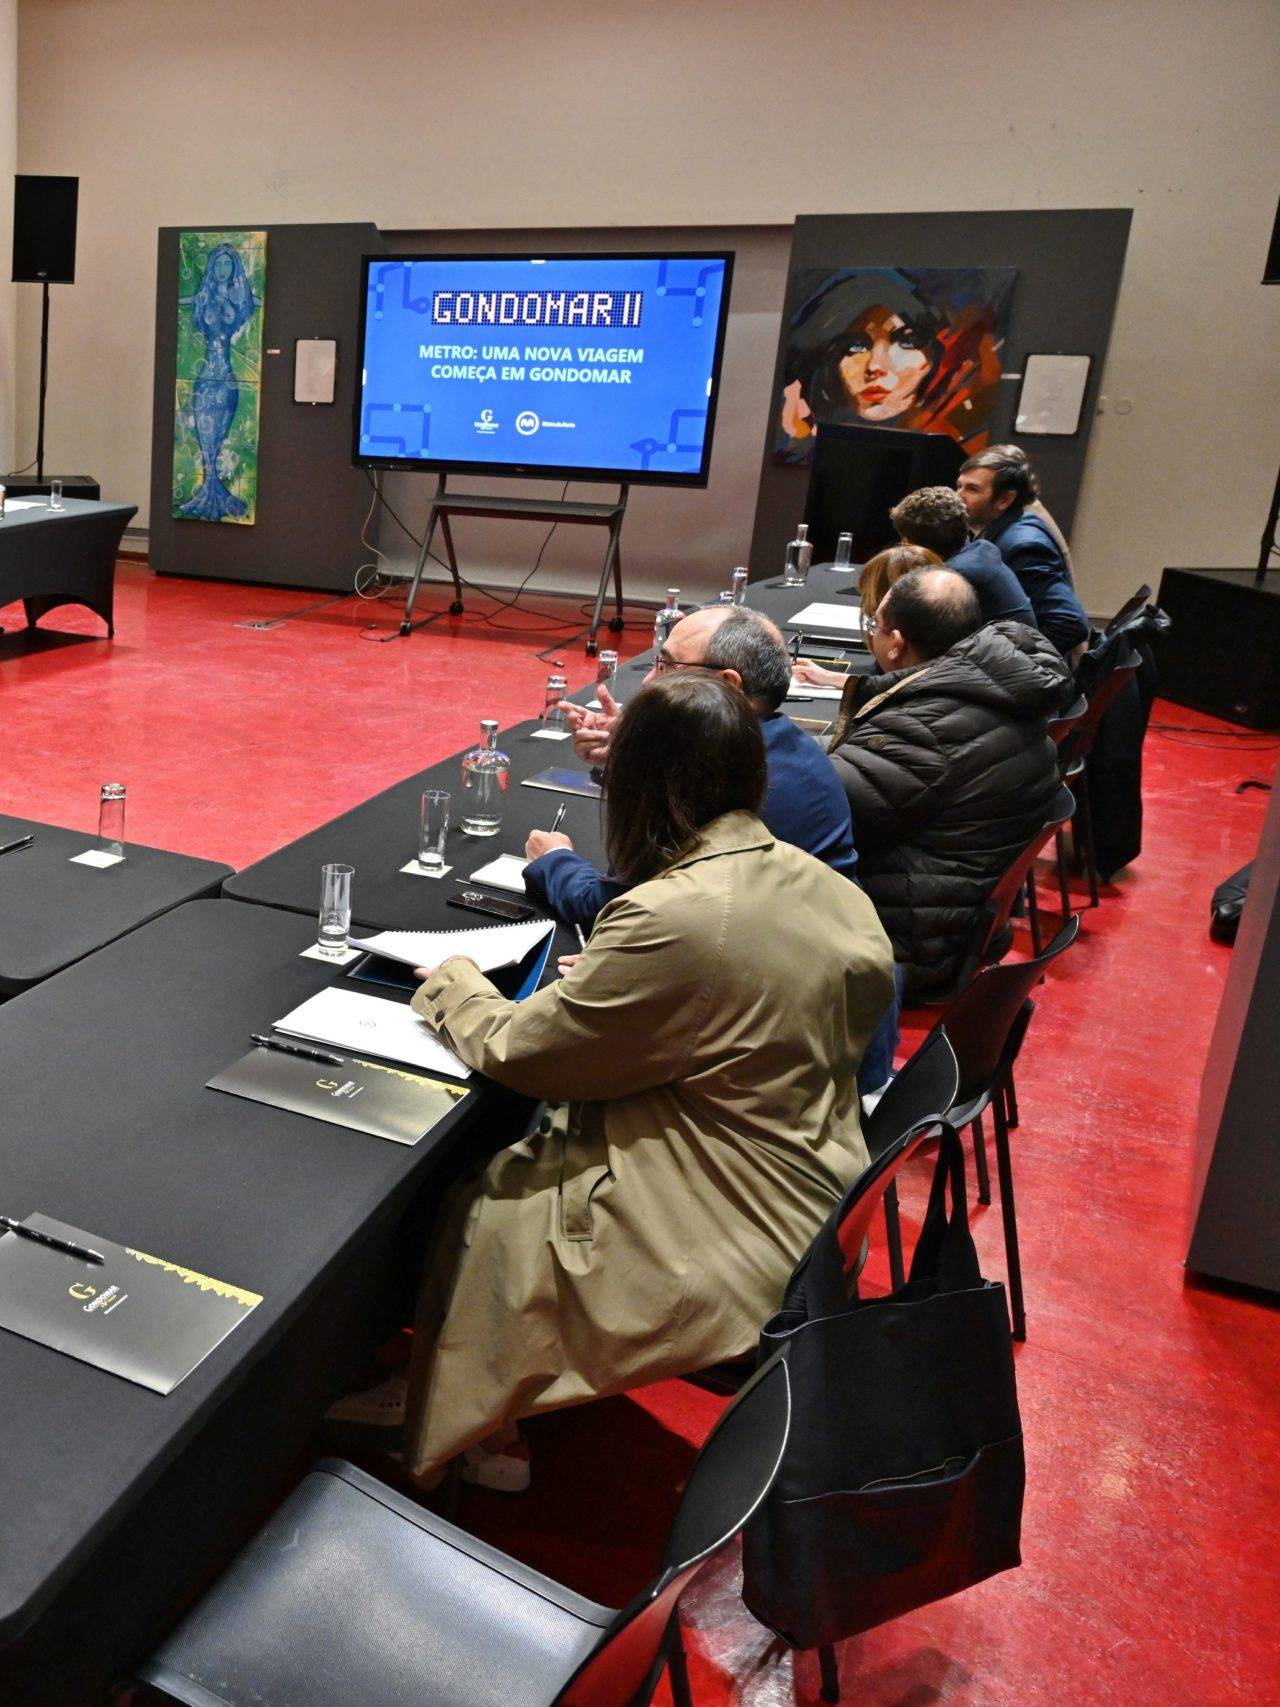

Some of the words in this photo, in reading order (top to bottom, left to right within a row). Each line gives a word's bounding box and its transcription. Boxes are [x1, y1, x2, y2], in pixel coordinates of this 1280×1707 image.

[433, 292, 613, 325] GONDOMAR
[622, 293, 641, 325] II
[419, 345, 478, 360] METRO:
[482, 346, 520, 361] UMA
[524, 347, 573, 362] NOVA
[577, 348, 645, 363] VIAGEM
[431, 365, 497, 382] COMEÇA
[501, 366, 525, 380] EM
[529, 367, 632, 384] GONDOMAR
